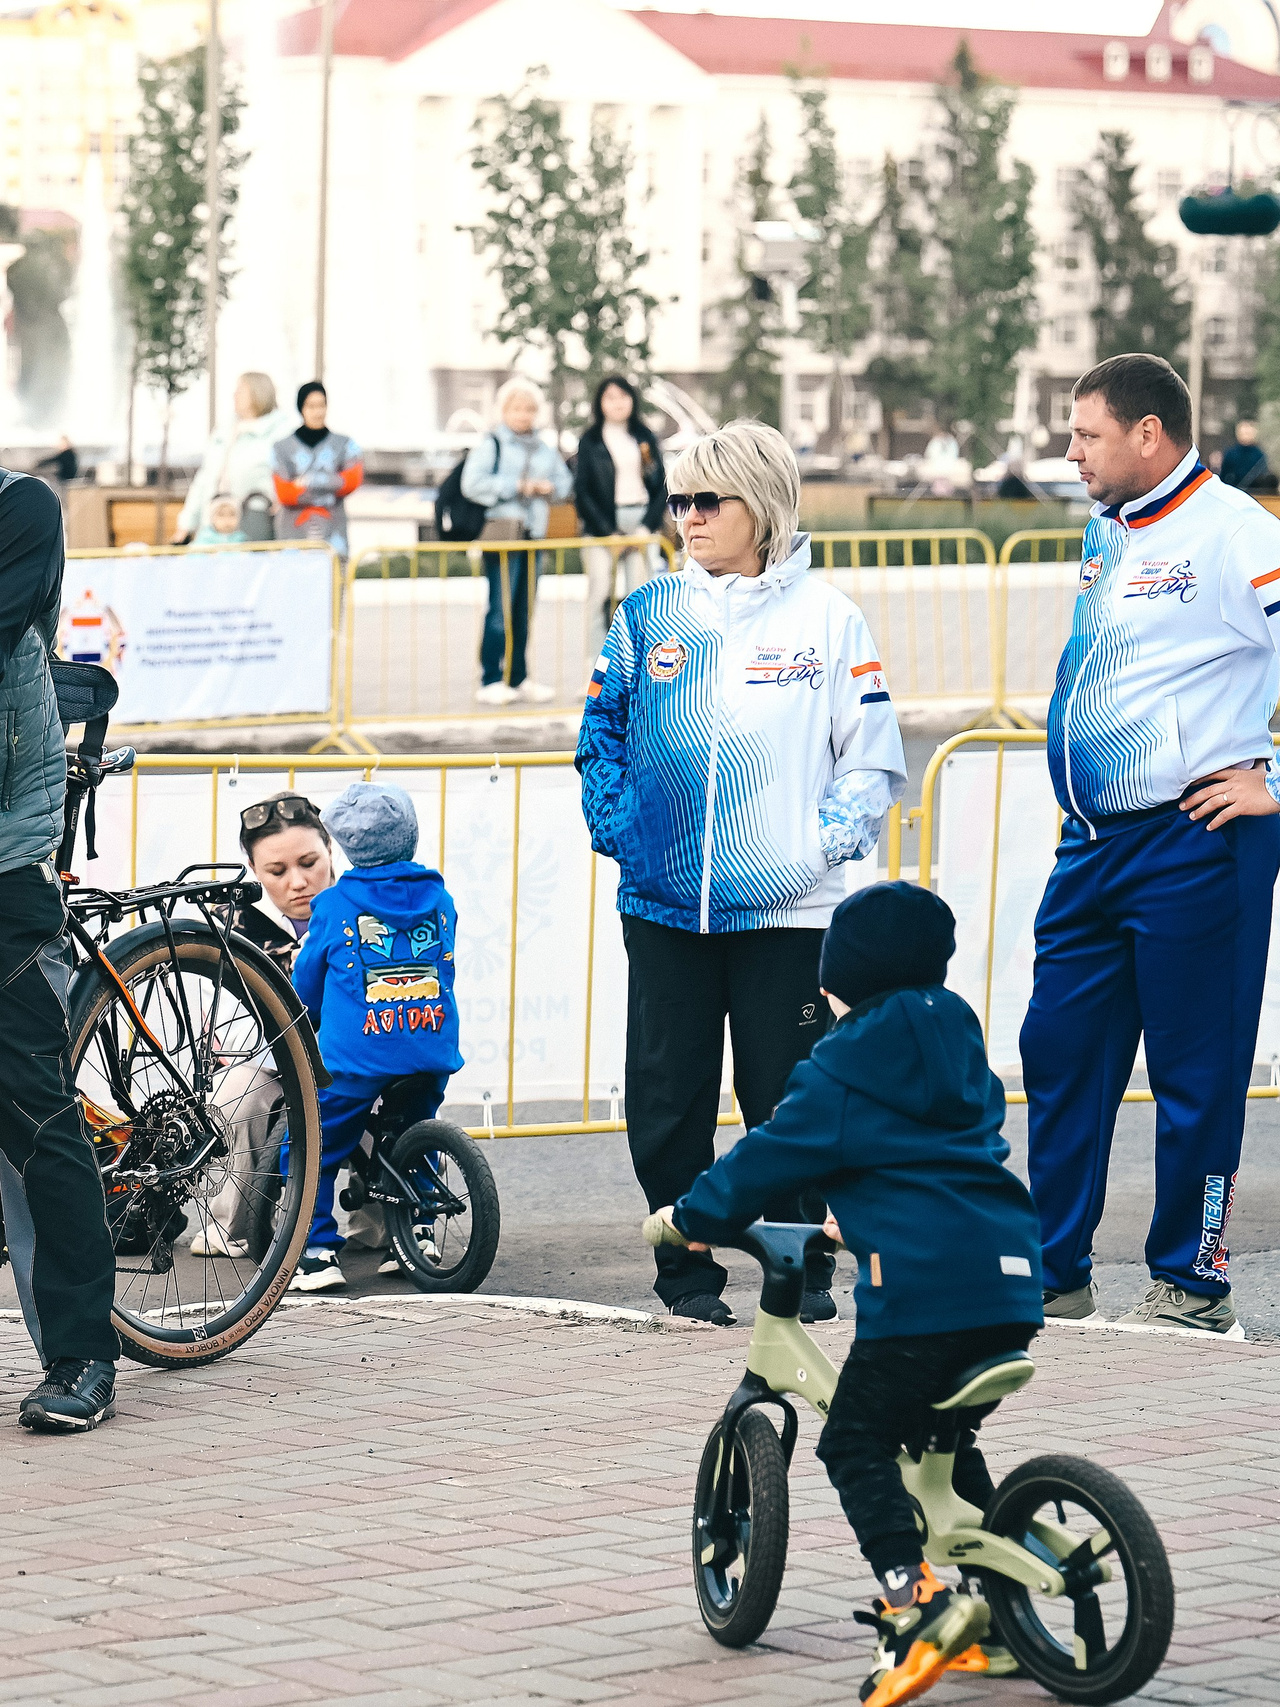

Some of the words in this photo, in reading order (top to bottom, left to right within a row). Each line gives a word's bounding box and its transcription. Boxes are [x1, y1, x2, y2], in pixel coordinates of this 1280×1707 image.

[757, 653, 782, 661] СШОР
[1203, 1175, 1225, 1230] TEAM
[261, 1267, 290, 1309] INNOVA
[243, 1306, 264, 1328] PRO
[184, 1339, 220, 1354] BOBCAT
